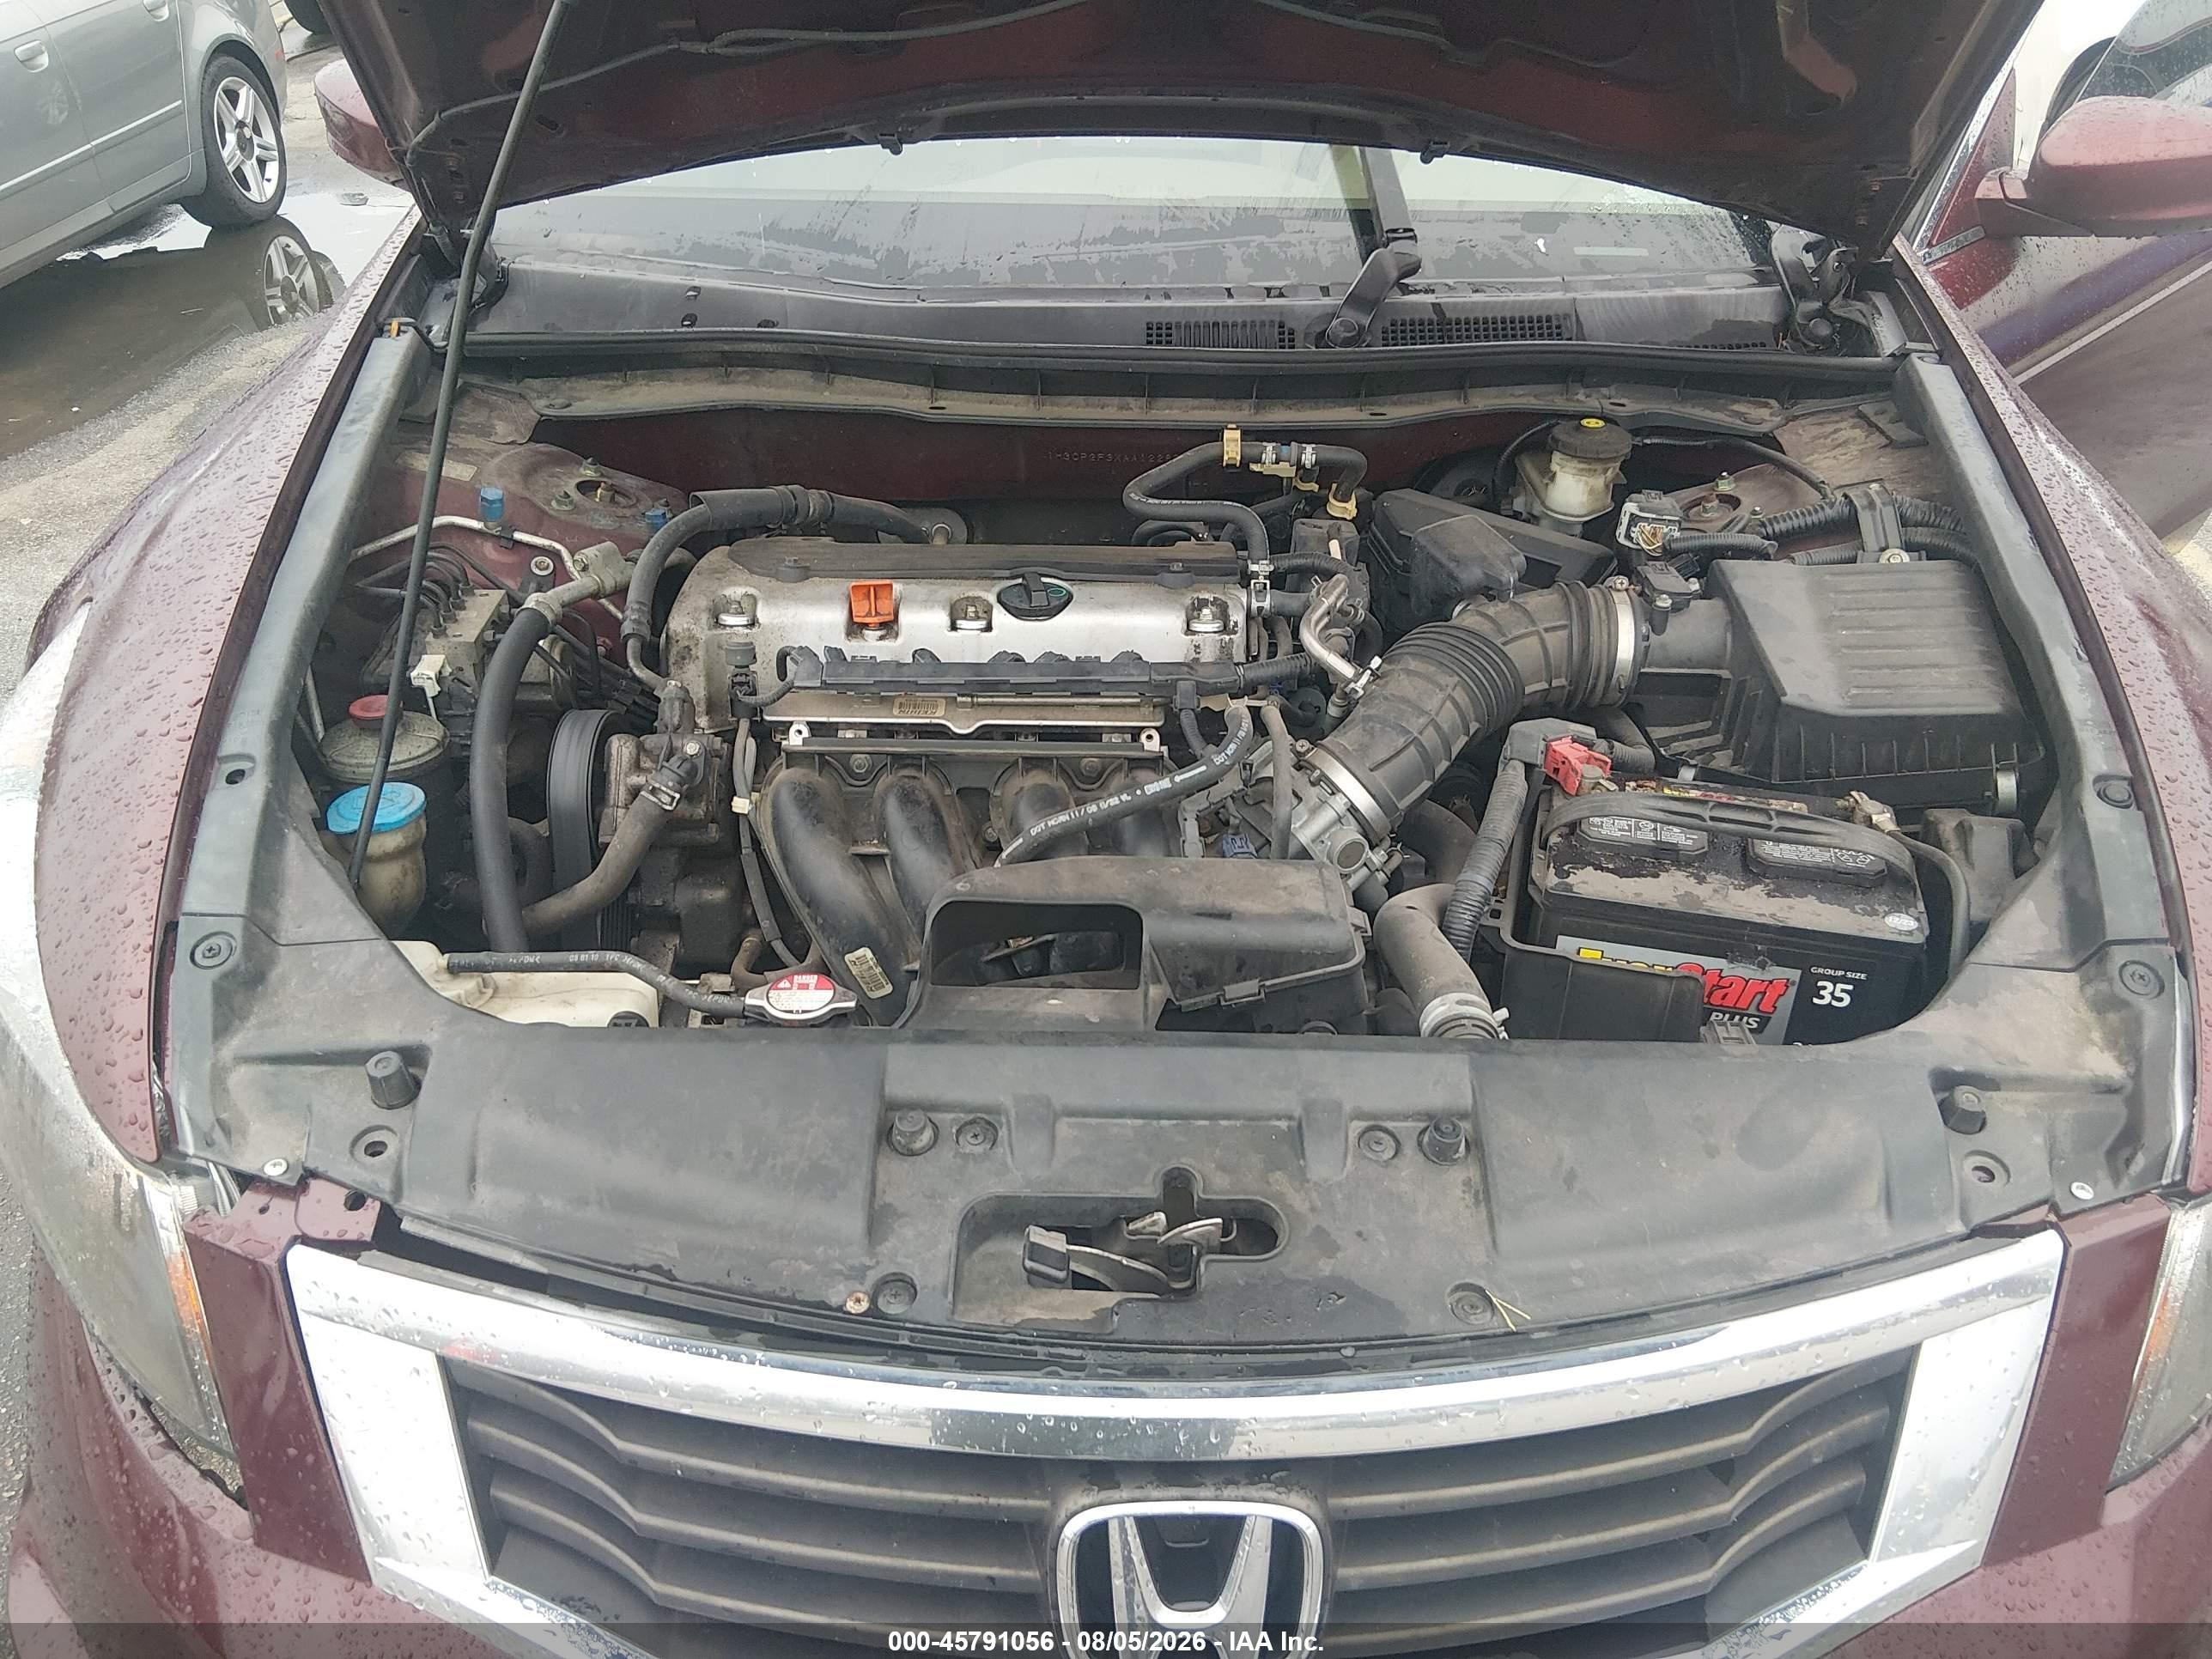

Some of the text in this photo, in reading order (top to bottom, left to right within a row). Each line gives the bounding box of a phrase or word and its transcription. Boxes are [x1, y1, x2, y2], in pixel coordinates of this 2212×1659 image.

[1810, 966, 1868, 981] GROUP SIZE
[1812, 981, 1854, 1007] 35
